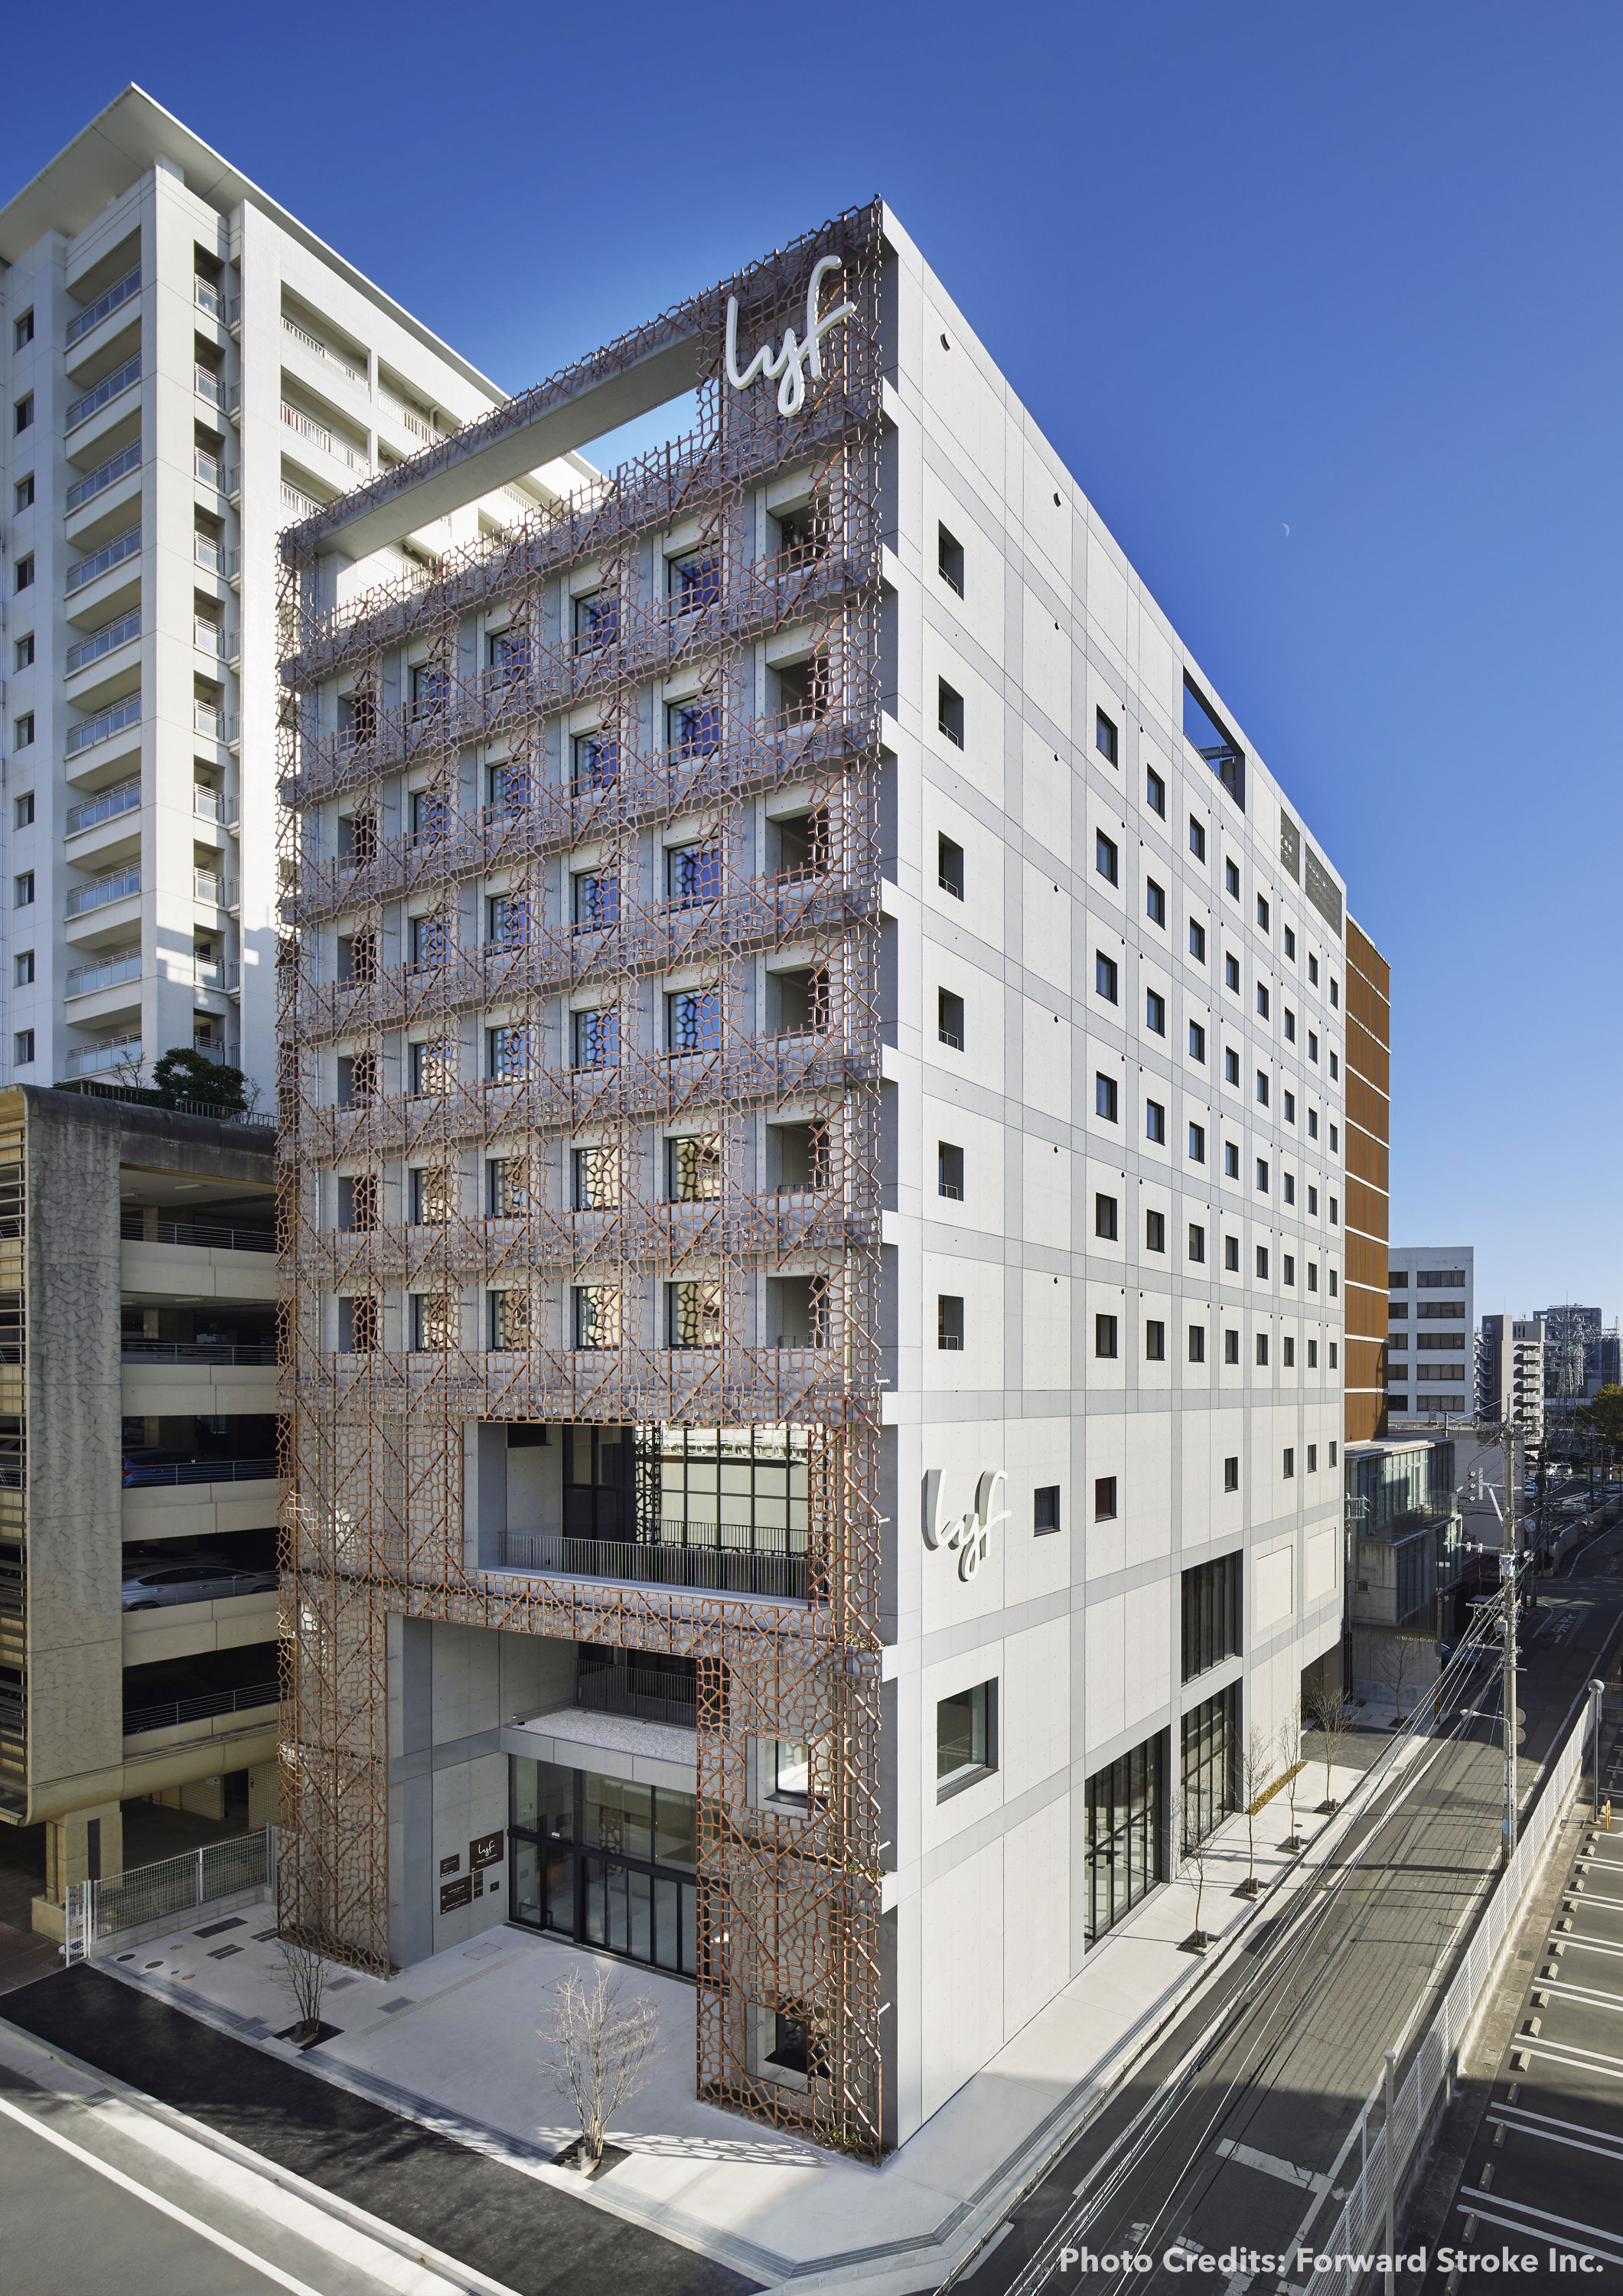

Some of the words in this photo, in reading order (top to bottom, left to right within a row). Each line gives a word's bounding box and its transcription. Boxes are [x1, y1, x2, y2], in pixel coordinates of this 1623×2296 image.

[726, 255, 857, 418] lyf
[921, 1468, 1012, 1583] lyf
[478, 1840, 495, 1857] lyf
